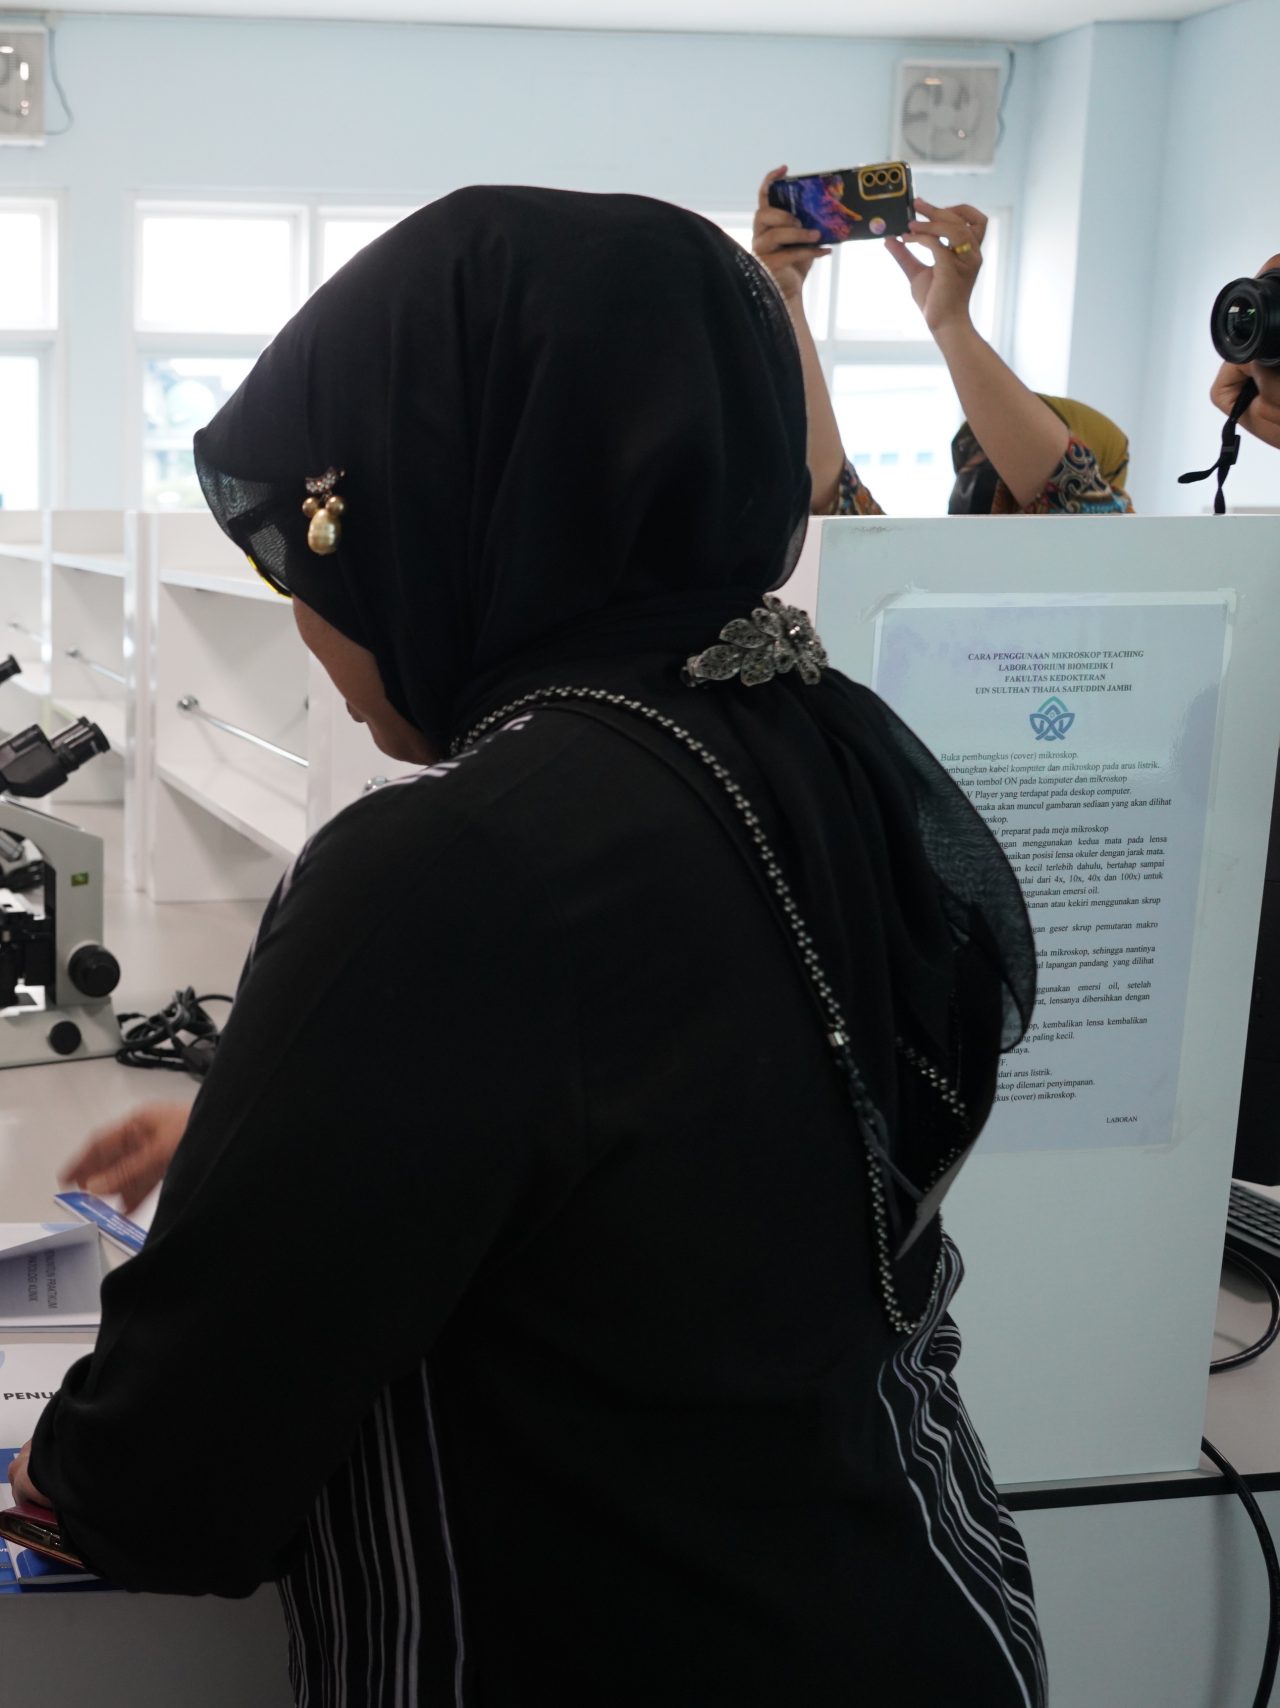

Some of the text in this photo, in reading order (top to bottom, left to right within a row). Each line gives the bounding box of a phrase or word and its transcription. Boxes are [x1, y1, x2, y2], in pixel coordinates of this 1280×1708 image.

[992, 652, 1050, 660] PENGGUNAAN
[1052, 651, 1101, 659] MIKROSKOP
[1102, 650, 1144, 658] TEACHING
[941, 753, 960, 761] Buka
[962, 753, 1008, 762] pembungkus
[1010, 752, 1036, 761] (cover)
[990, 765, 1008, 773] kabel
[1010, 765, 1045, 774] komputer
[1062, 763, 1100, 772] mikroskop
[1102, 762, 1119, 772] pada
[976, 778, 1002, 786] tombol
[1020, 777, 1036, 786] pada
[1038, 776, 1072, 786] komputer
[1090, 775, 1128, 784] mikroskop
[975, 790, 998, 800] Player
[1000, 791, 1018, 800] yang
[1020, 790, 1048, 799] terdapat
[1050, 788, 1068, 798] pada
[1070, 788, 1095, 797] deskop
[1016, 802, 1044, 810] muncul
[1046, 800, 1080, 810] gambaran
[1082, 800, 1109, 808] sediaan
[1111, 800, 1128, 809] yang
[1149, 798, 1172, 806] dilihat
[1002, 828, 1030, 837] preparat
[1032, 827, 1050, 836] pada
[1052, 826, 1069, 836] meja
[1071, 825, 1108, 834] mikroskop
[1022, 839, 1072, 848] menggunakan
[1127, 836, 1144, 845] pada
[1149, 835, 1168, 843] lensa
[1032, 852, 1054, 860] posisi
[1055, 850, 1074, 858] lensa
[1076, 850, 1098, 858] okuler
[1100, 850, 1125, 858] dengan
[1126, 848, 1144, 858] jarak
[1046, 863, 1073, 871] terlebih
[1076, 862, 1103, 870] dahulu,
[1106, 861, 1136, 870] bertahap
[1140, 860, 1164, 870] sampai
[1036, 875, 1051, 883] dari
[1122, 872, 1140, 881] 100x)
[1144, 872, 1163, 880] untuk
[1063, 887, 1086, 895] emersi
[1068, 899, 1088, 908] kekiri
[1091, 898, 1139, 908] menggunakan
[1142, 896, 1160, 906] skrup
[1050, 926, 1068, 934] geser
[1072, 924, 1092, 932] skrup
[1096, 922, 1132, 932] pemutaran
[1136, 920, 1158, 928] makro
[1050, 948, 1090, 956] mikroskop,
[1092, 946, 1123, 956] sehingga
[1126, 944, 1156, 954] nantinya
[1046, 961, 1078, 970] lapangan
[1079, 960, 1108, 969] pandang
[1112, 958, 1130, 968] yang
[1132, 957, 1154, 965] dilihat
[1078, 983, 1100, 992] emersi
[1128, 980, 1152, 988] setelah
[1050, 996, 1080, 1006] lensanya
[1082, 994, 1122, 1003] dibersihkan
[1125, 993, 1150, 1002] dengan
[1042, 1020, 1083, 1029] kembalikan
[1086, 1018, 1104, 1026] lensa
[1107, 1016, 1148, 1026] kembalikan
[1032, 1033, 1054, 1042] paling
[1056, 1032, 1074, 1040] kecil.
[1014, 1070, 1028, 1078] arus
[1030, 1068, 1052, 1076] listrik.
[1016, 1080, 1045, 1089] dilemari
[1046, 1078, 1095, 1089] penyimpanan.
[1011, 1092, 1036, 1102] (cover)
[1038, 1091, 1076, 1100] mikroskop.
[1106, 1116, 1138, 1124] LABORAN
